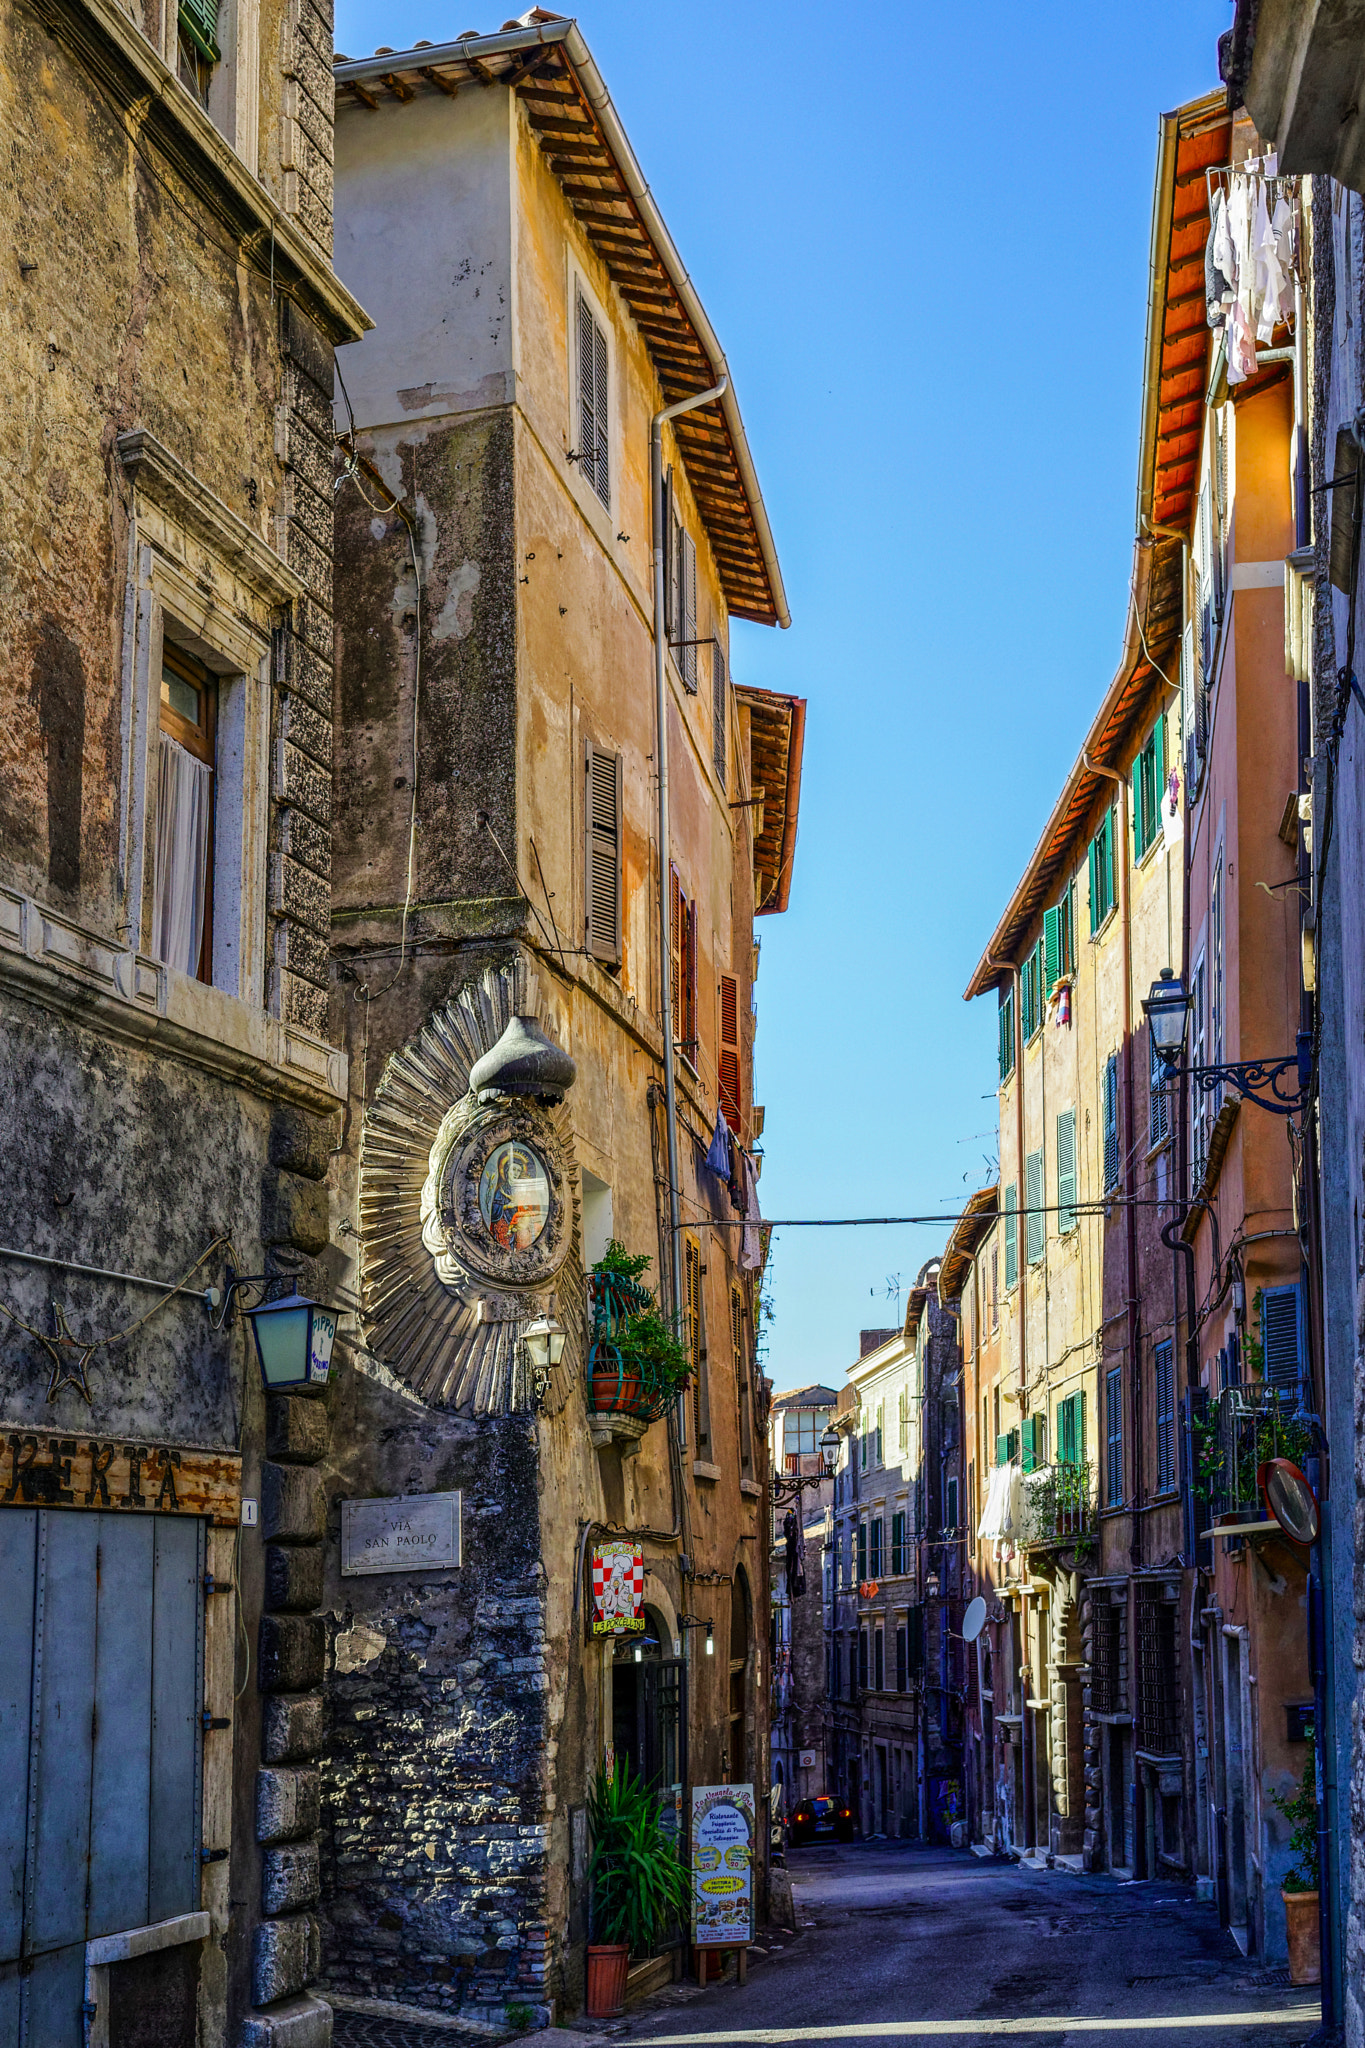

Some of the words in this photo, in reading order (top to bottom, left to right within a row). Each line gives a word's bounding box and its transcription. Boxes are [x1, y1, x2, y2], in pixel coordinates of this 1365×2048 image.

[313, 1316, 334, 1338] PIPPO
[247, 1505, 252, 1520] 1
[390, 1521, 412, 1531] VIA
[365, 1538, 389, 1549] SAN
[397, 1533, 437, 1546] PAOLO
[600, 1622, 605, 1632] 3
[606, 1617, 644, 1630] PORCELLINI
